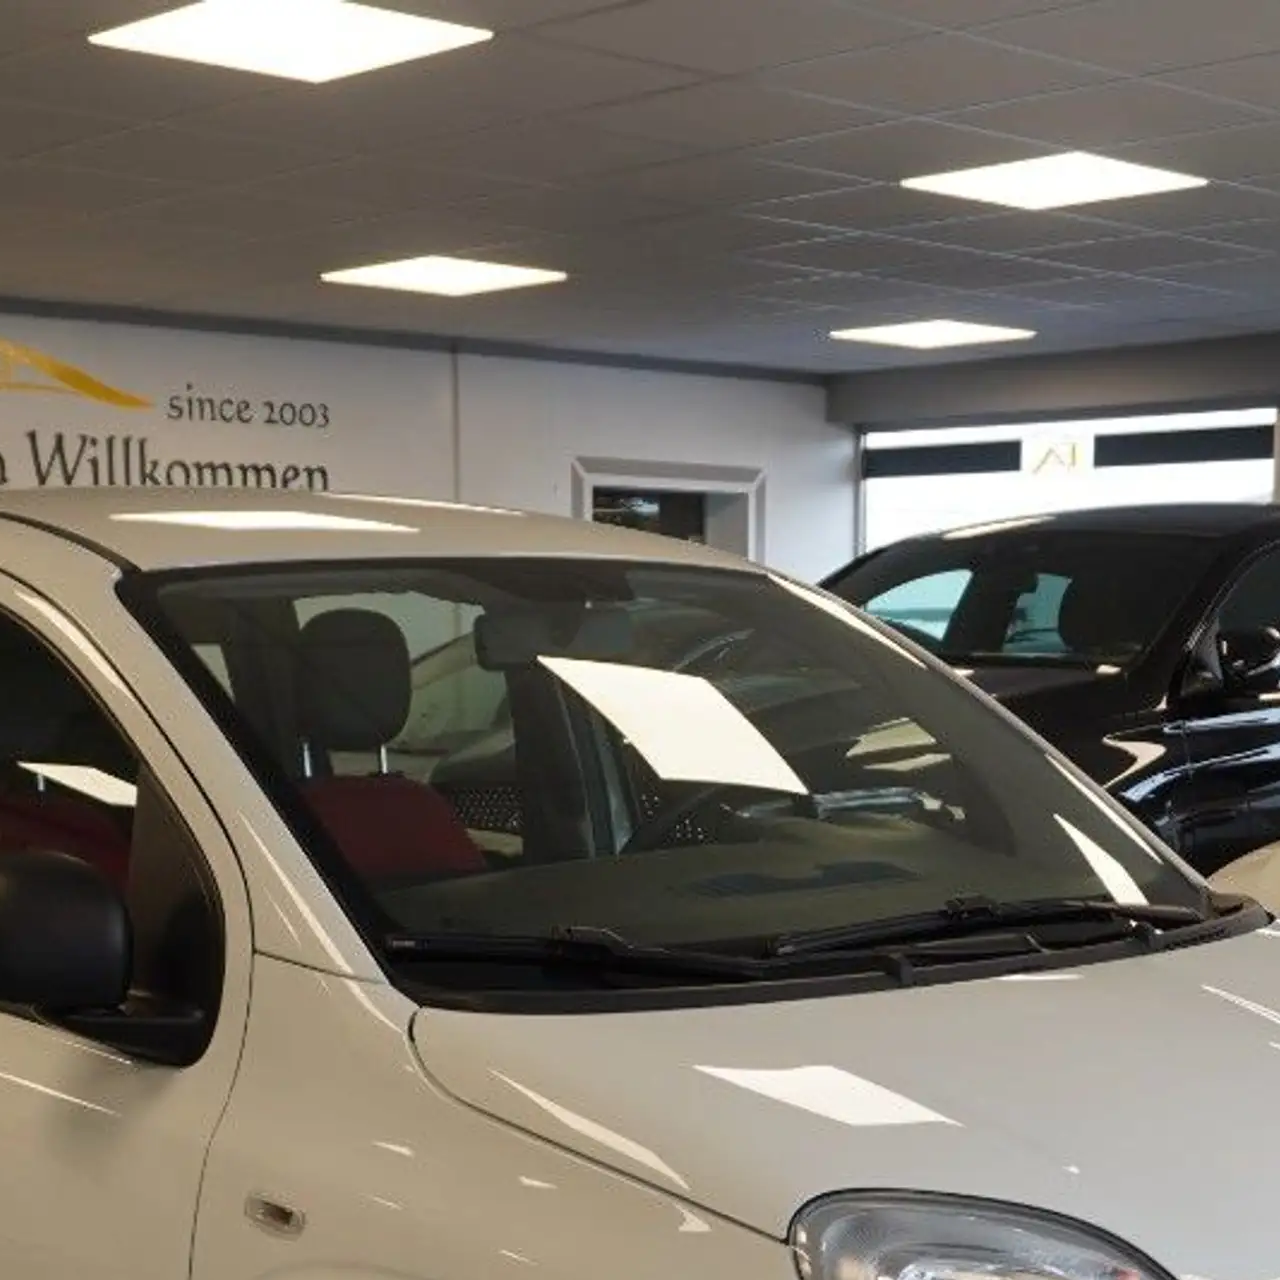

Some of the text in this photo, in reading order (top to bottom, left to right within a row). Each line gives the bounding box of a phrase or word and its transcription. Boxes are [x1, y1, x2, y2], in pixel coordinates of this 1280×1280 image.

[166, 382, 330, 428] since 2003
[25, 429, 329, 492] Willkommen
